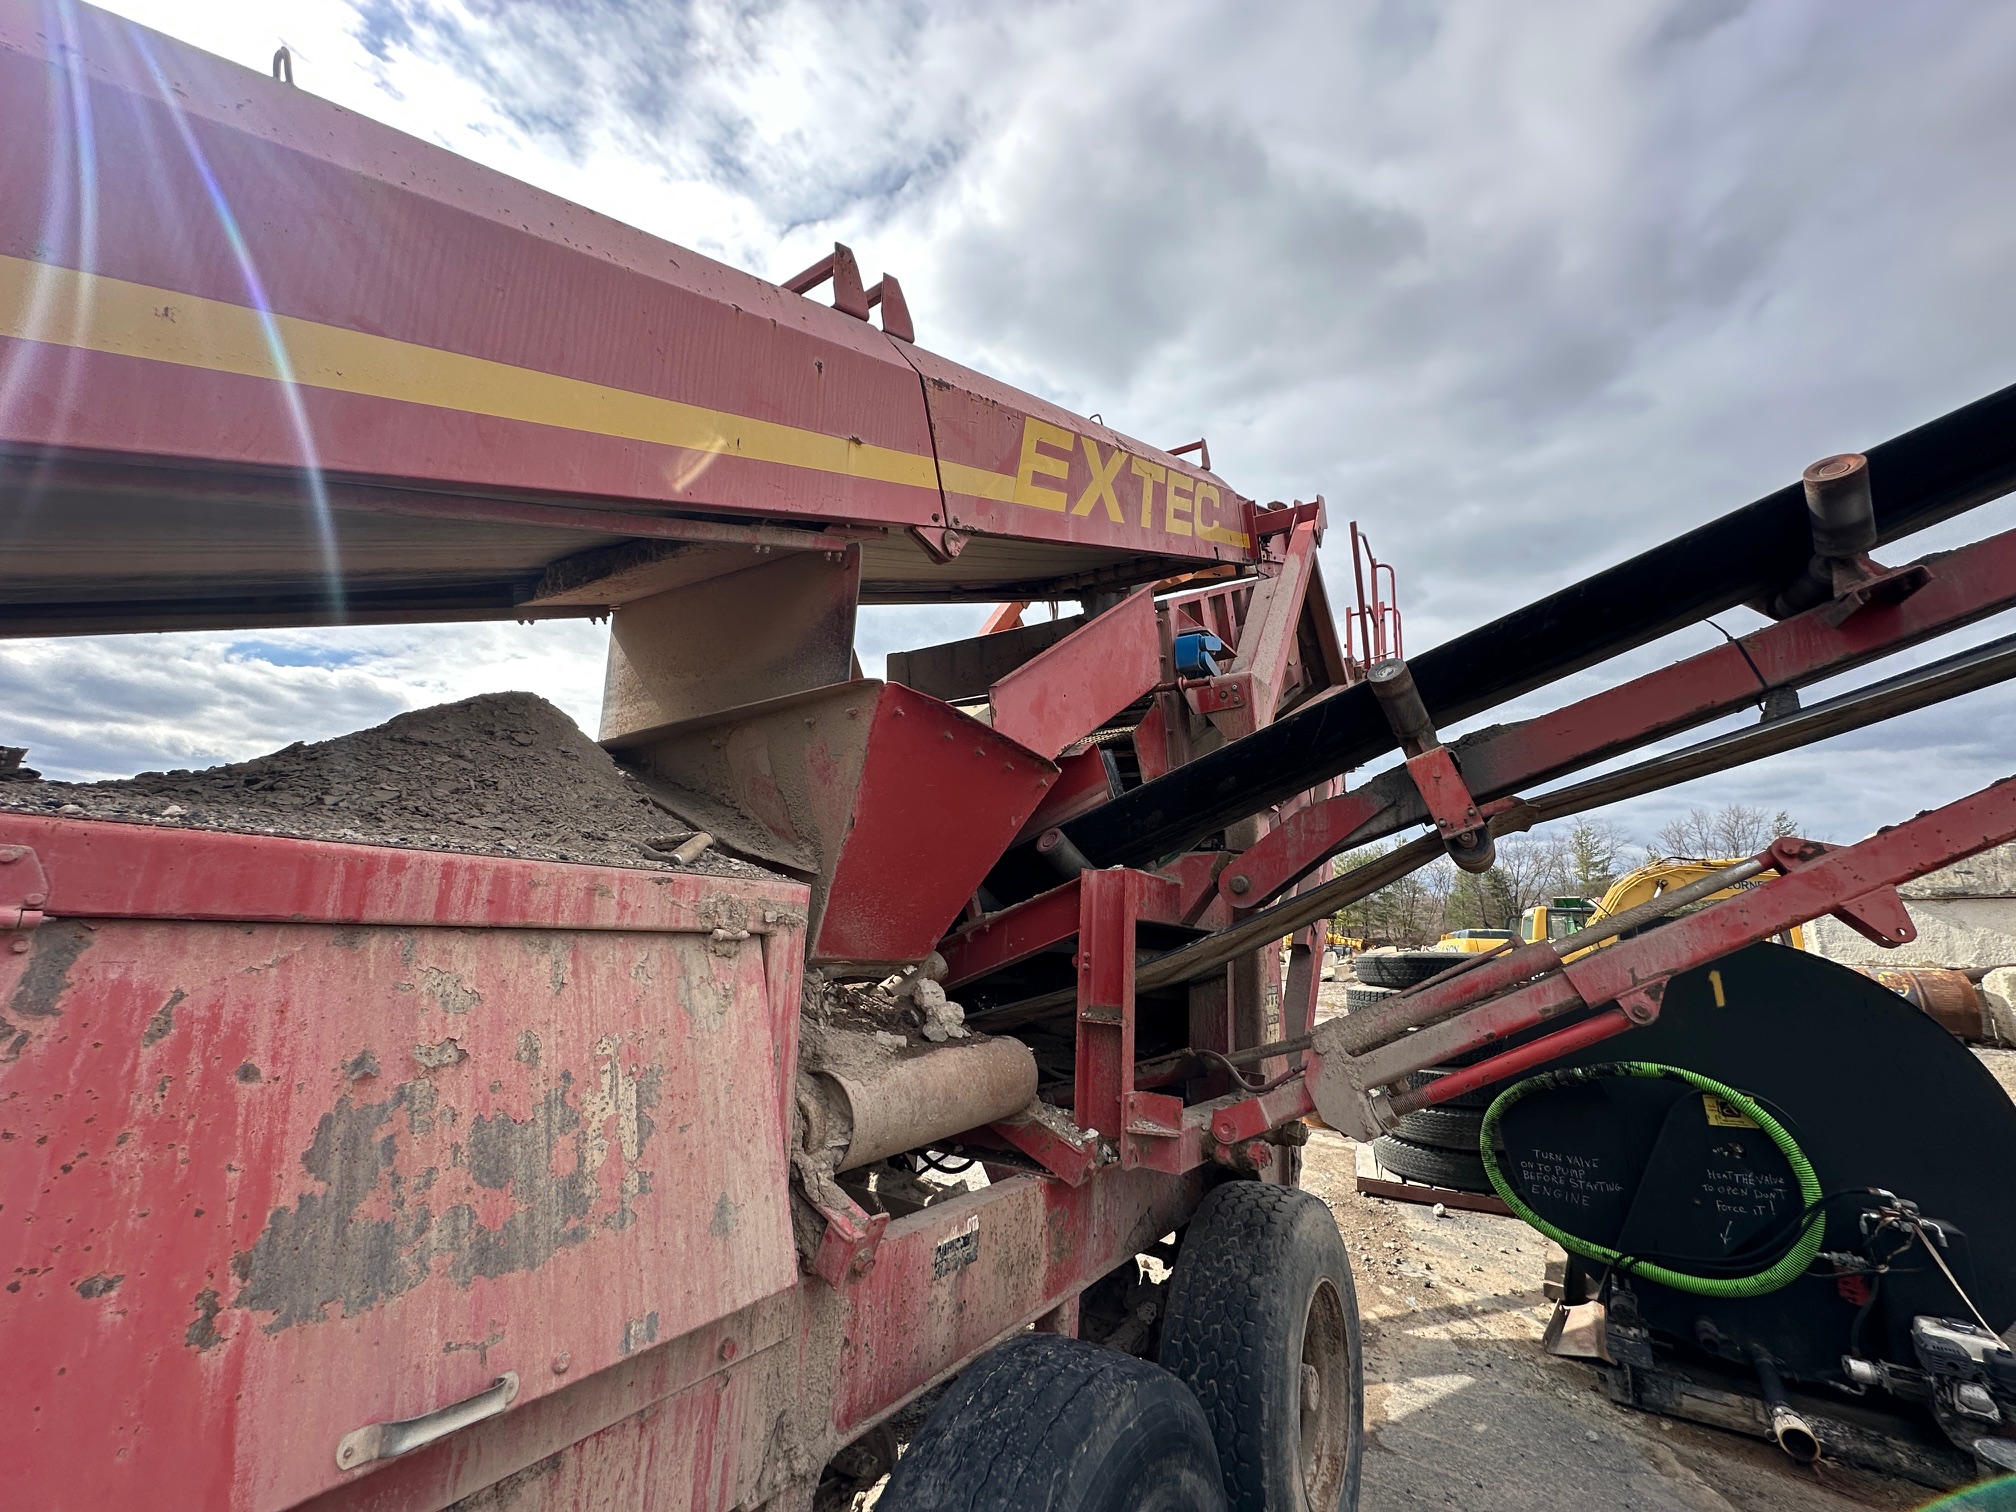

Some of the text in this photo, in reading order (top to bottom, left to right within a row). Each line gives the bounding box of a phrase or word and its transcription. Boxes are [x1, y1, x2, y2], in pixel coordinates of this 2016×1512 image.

[1013, 416, 1221, 543] EXTEC
[1708, 970, 1726, 1008] 1
[1532, 1149, 1562, 1162] TURN
[1523, 1170, 1565, 1184] BEFORE
[1554, 1165, 1586, 1180] PUMP
[1531, 1184, 1591, 1206] ENGINE
